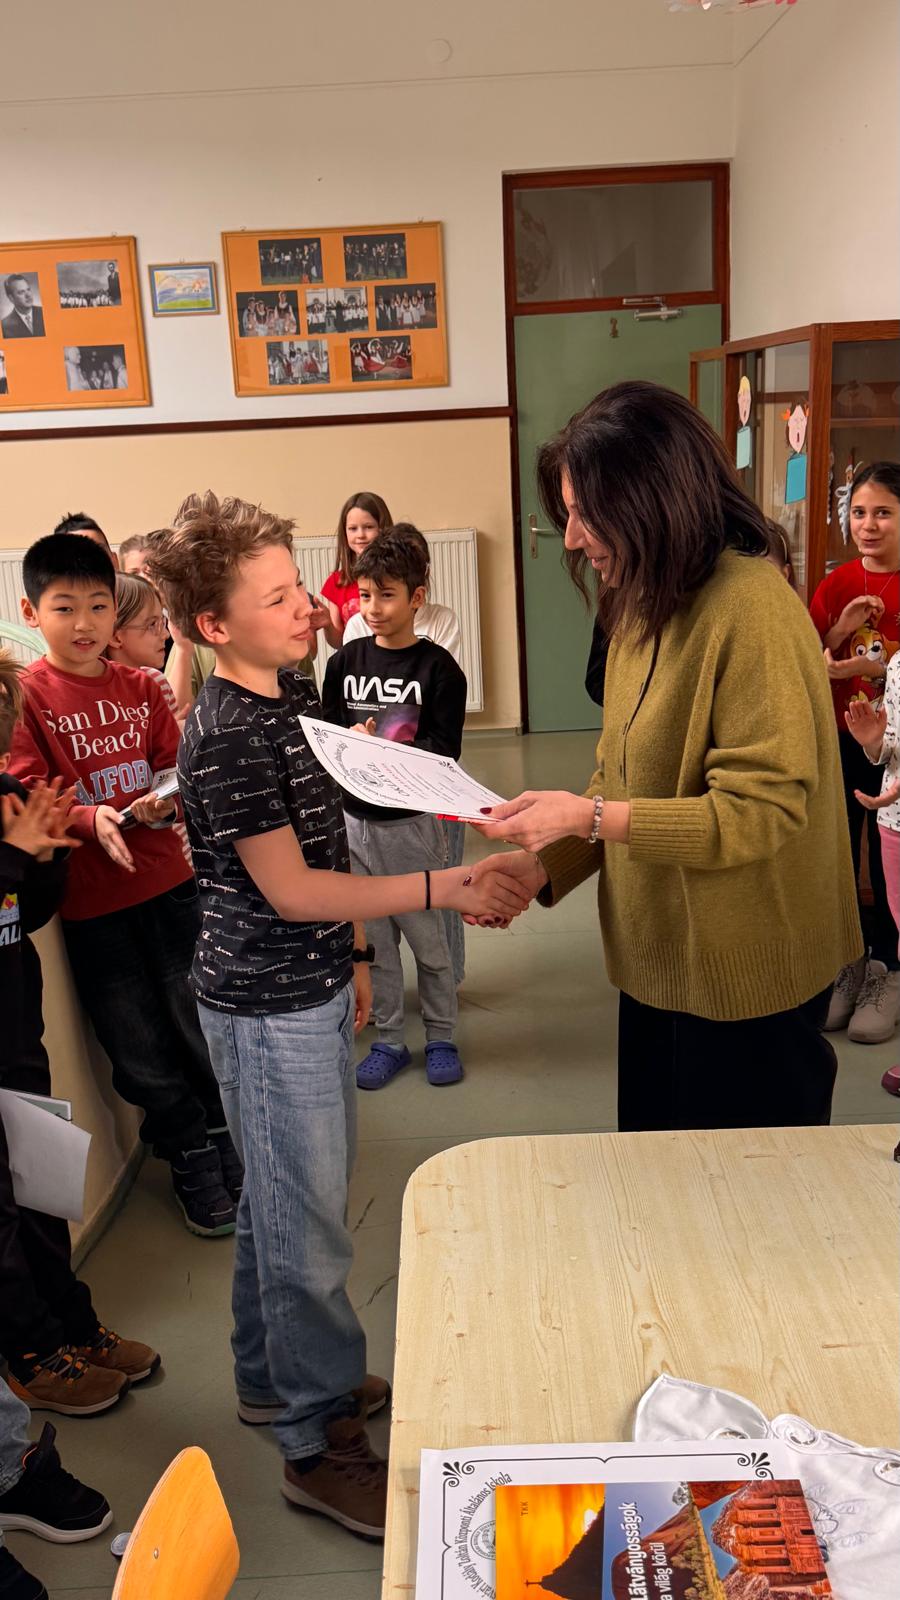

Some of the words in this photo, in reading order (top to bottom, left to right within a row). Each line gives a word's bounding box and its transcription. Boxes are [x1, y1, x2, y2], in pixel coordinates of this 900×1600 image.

[343, 674, 422, 705] NASA
[41, 709, 93, 735] San
[95, 699, 150, 729] Dieg
[69, 723, 141, 761] Beach
[191, 765, 220, 777] mpion
[198, 878, 239, 894] Champion
[275, 968, 332, 985] Champion
[484, 1471, 513, 1492] Iskola
[459, 1487, 492, 1517] Általános
[454, 1516, 472, 1545] Központi
[455, 1544, 471, 1567] Zoltán
[618, 1502, 648, 1600] Látványosságok
[649, 1542, 668, 1567] körül
[461, 1563, 484, 1590] Kodály
[653, 1567, 673, 1594] világ
